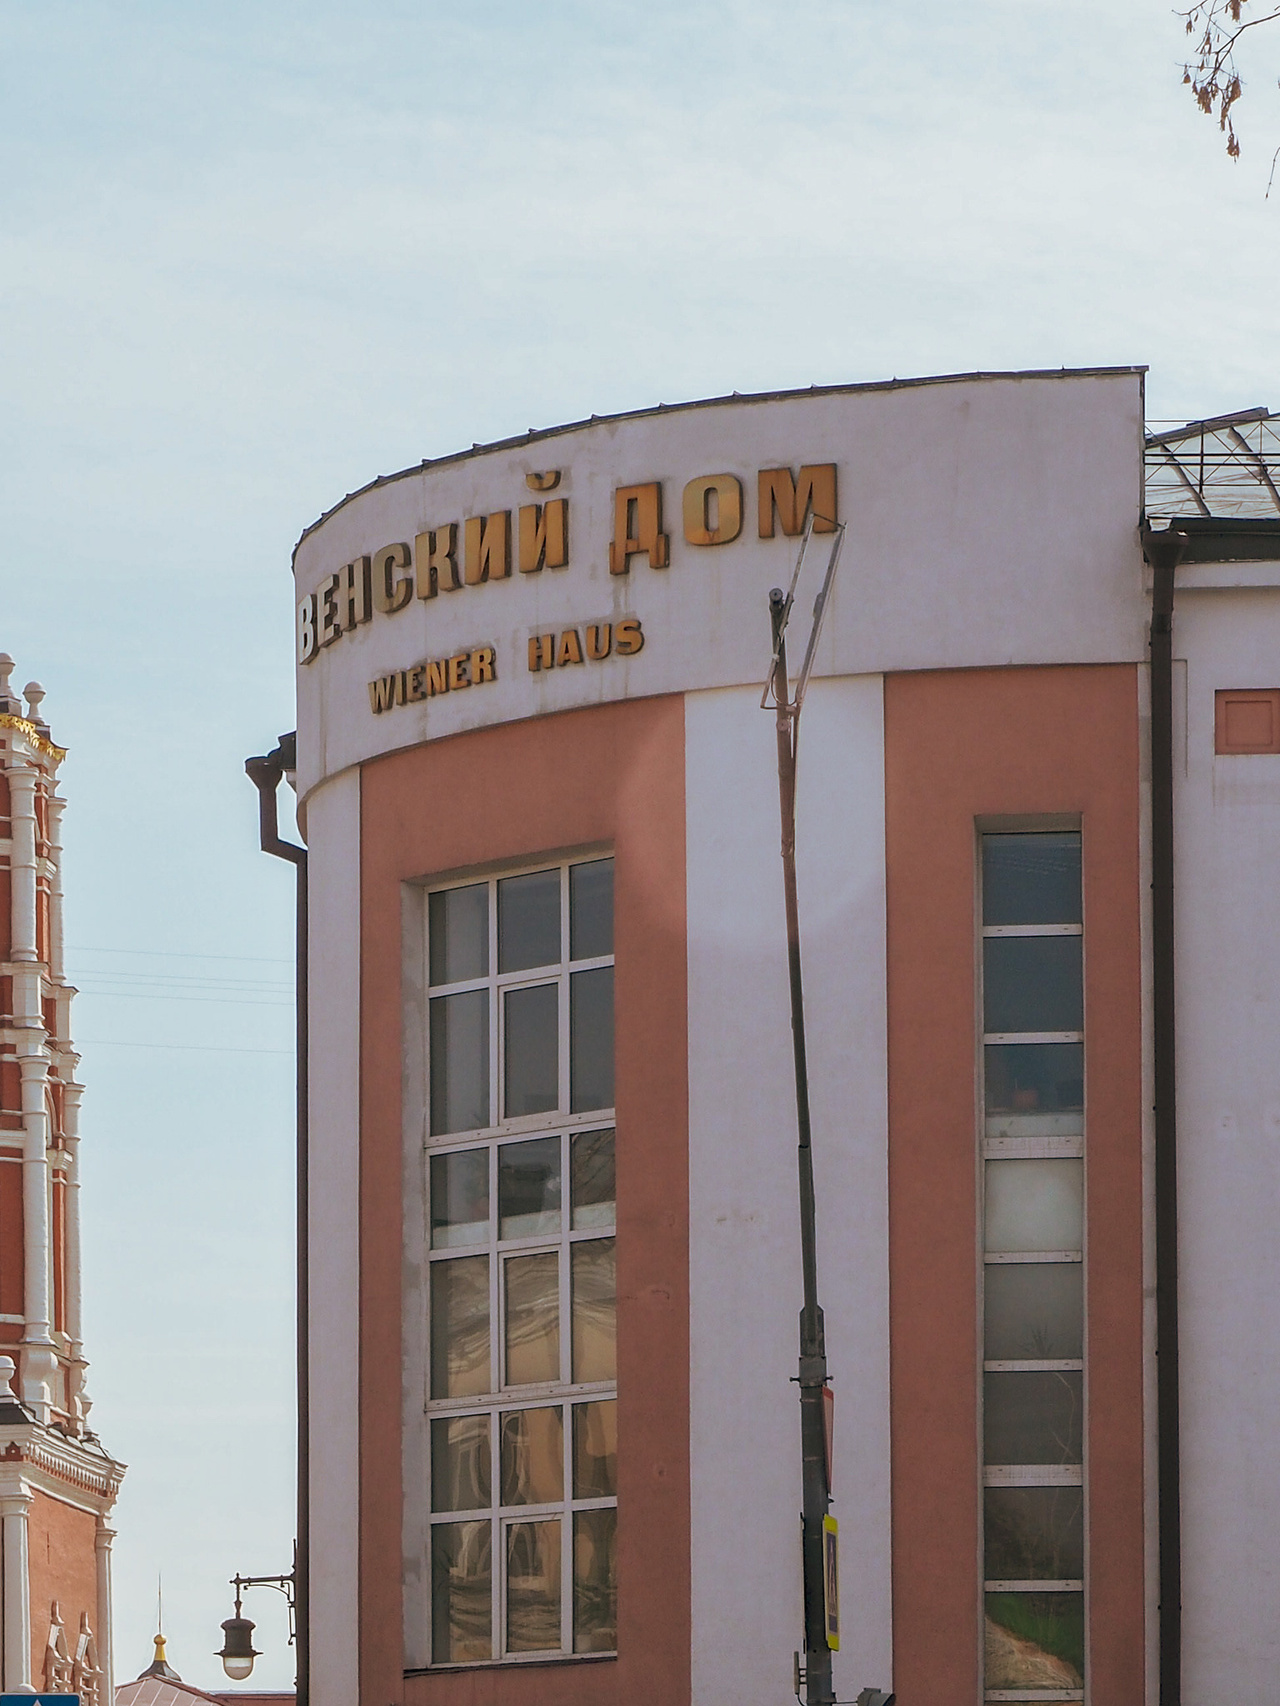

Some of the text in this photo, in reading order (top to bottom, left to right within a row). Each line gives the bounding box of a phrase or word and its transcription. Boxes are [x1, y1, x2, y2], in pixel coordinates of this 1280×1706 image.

[297, 462, 838, 666] ВЕНСКИЙ ДОМ
[367, 619, 645, 715] WIENER HAUS
